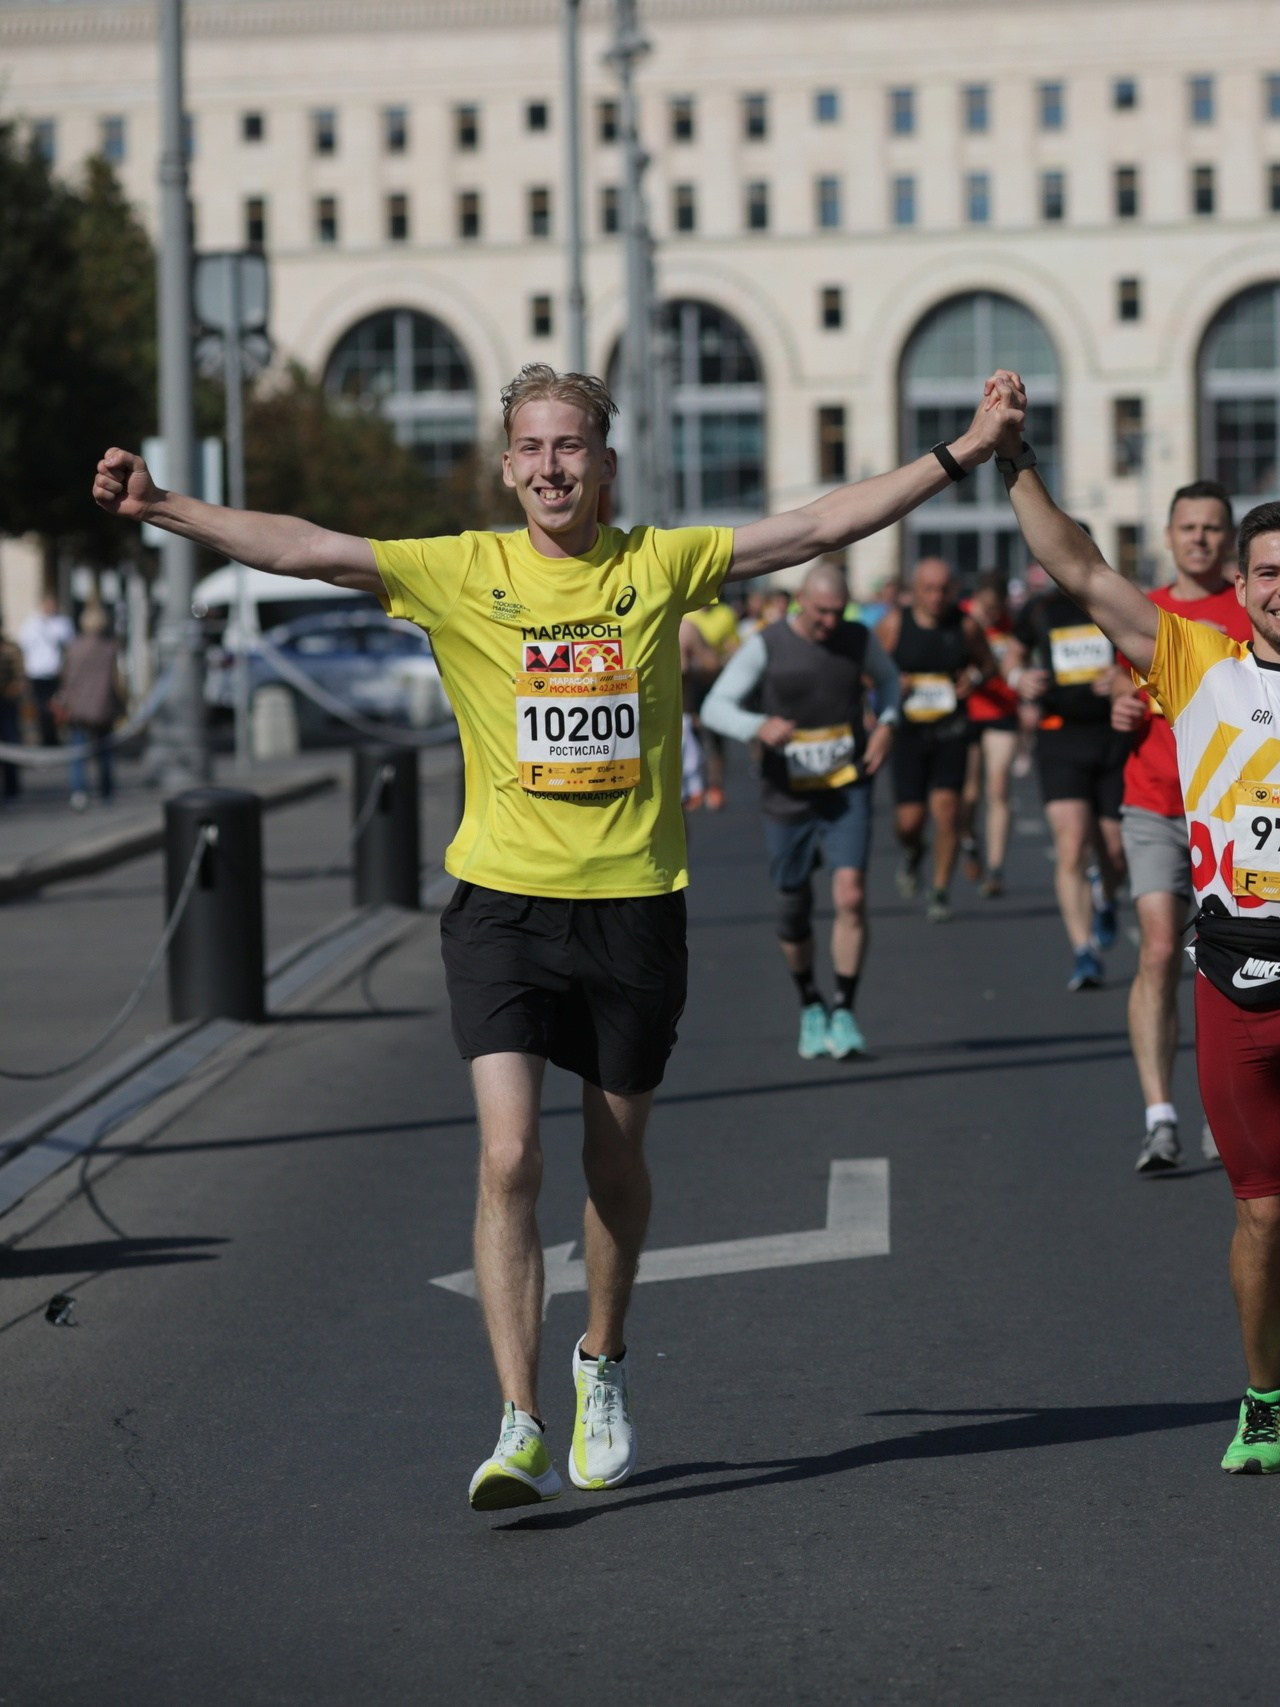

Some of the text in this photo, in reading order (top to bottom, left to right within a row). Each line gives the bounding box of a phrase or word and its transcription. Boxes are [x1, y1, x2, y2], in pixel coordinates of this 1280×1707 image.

[522, 624, 622, 640] МАРАФОН
[550, 677, 598, 686] МАРАФОН
[550, 685, 590, 694] МОСКВА
[524, 703, 635, 742] 10200
[549, 745, 610, 756] РОСТИСЛАВ
[531, 765, 543, 785] F
[527, 789, 628, 801] MOSCOW MARATHON
[1245, 872, 1258, 890] F
